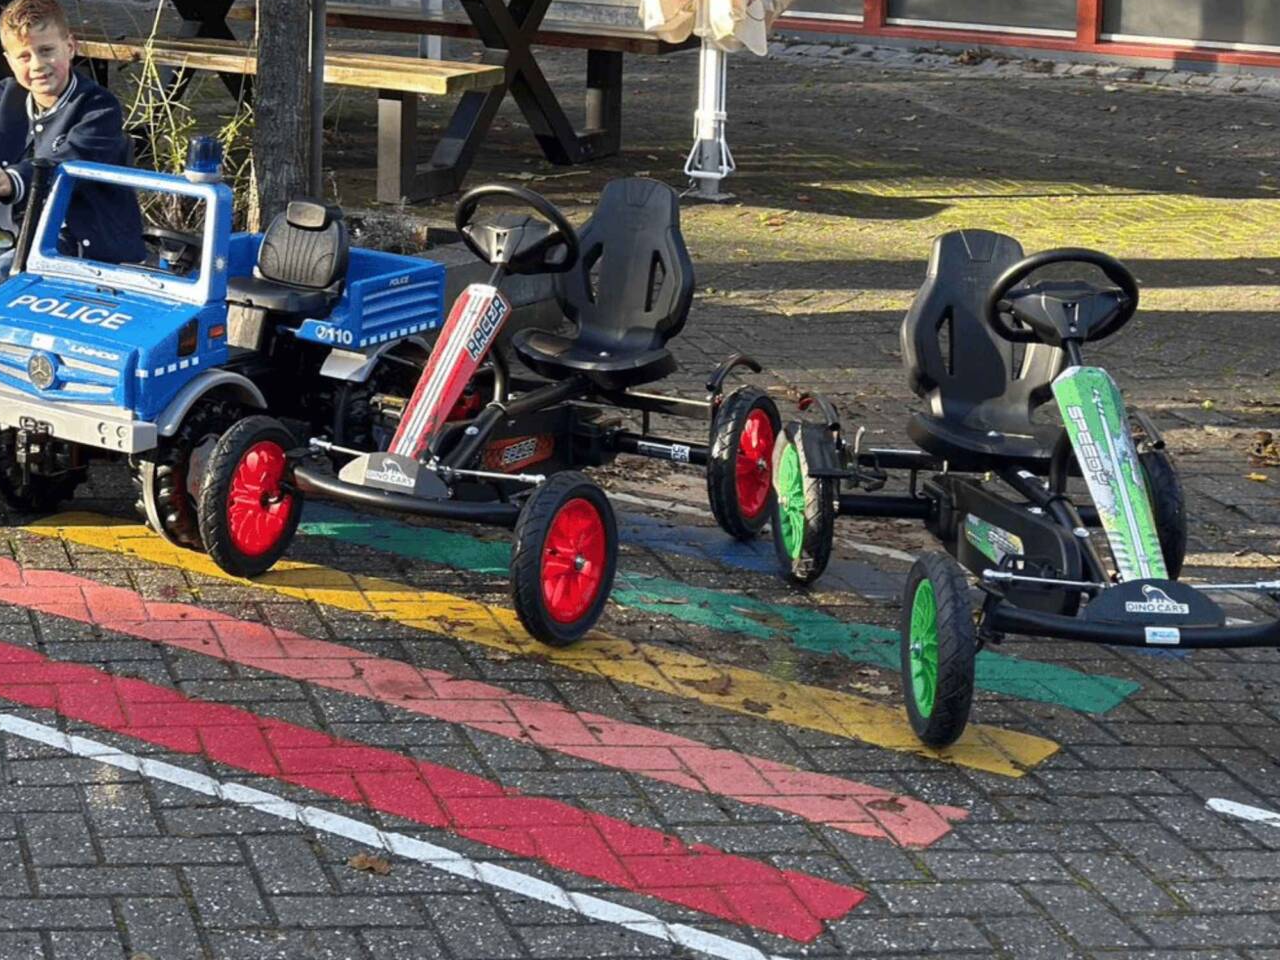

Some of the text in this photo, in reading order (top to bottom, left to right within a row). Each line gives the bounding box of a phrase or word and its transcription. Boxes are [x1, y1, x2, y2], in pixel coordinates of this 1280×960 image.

[6, 294, 133, 332] POLICE
[465, 292, 508, 361] RACER
[326, 328, 353, 345] 110
[1066, 404, 1111, 486] SPEEDY
[1126, 601, 1186, 614] DINO CARS
